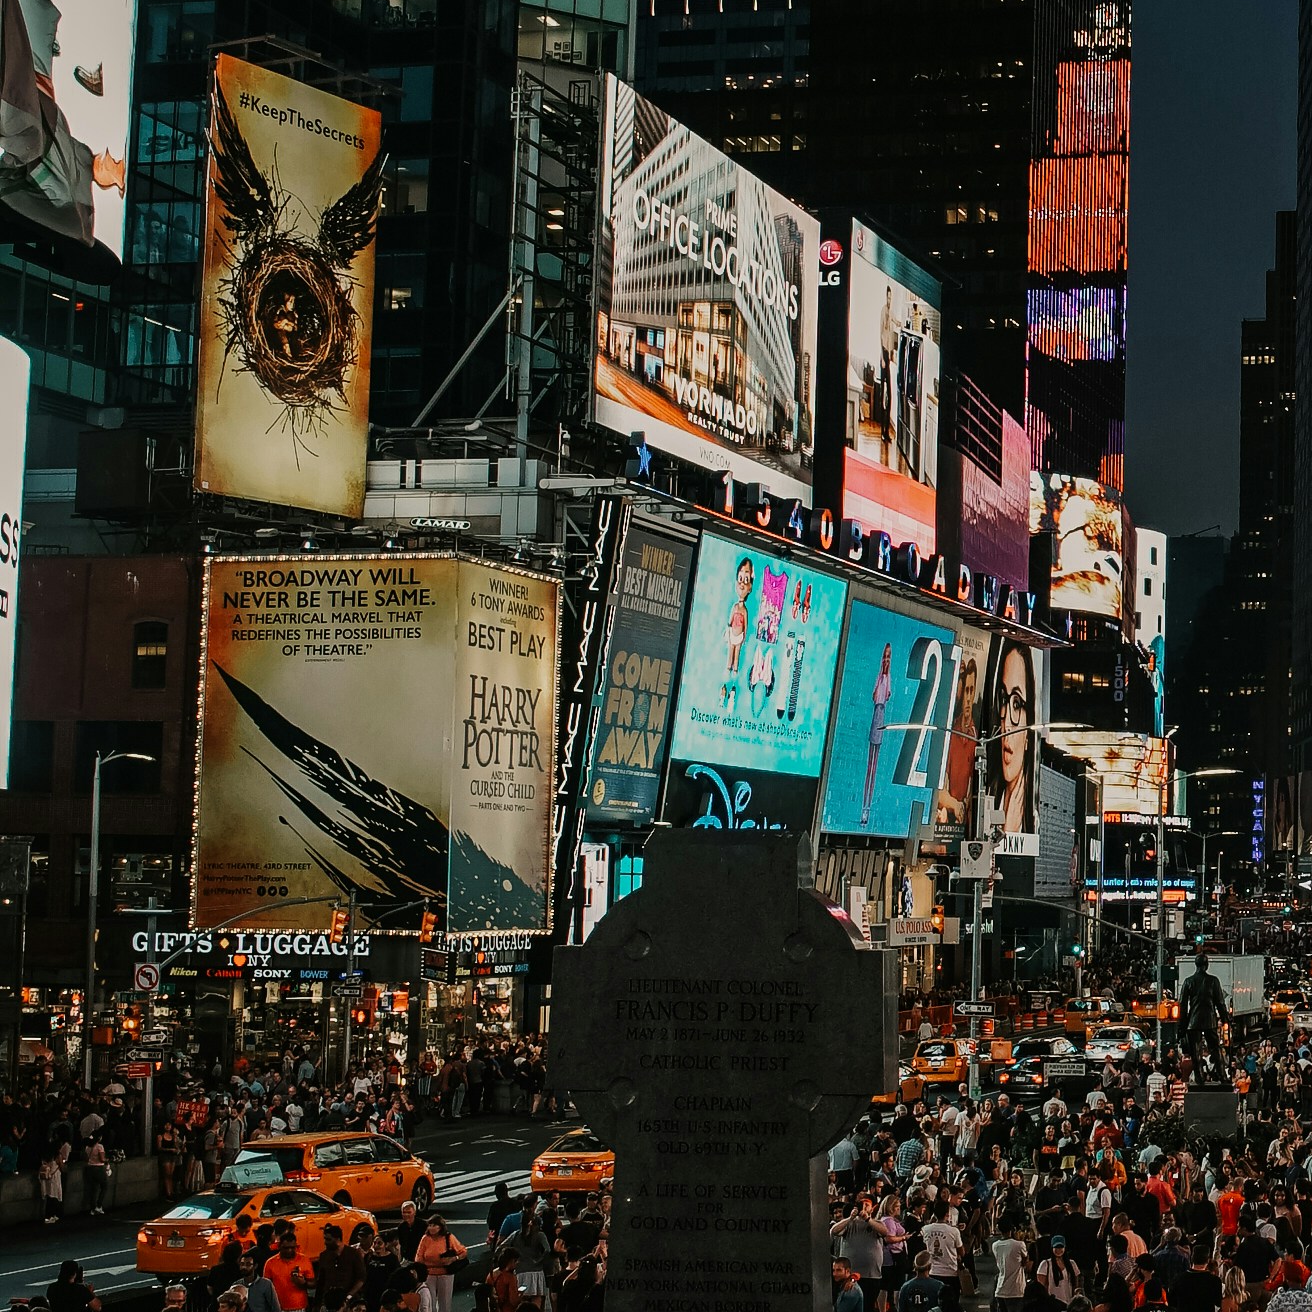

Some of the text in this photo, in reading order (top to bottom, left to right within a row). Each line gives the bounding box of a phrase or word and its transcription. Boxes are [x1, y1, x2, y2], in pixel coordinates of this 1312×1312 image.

[239, 91, 365, 151] #KeepTheSecrets
[706, 198, 737, 238] PRIME
[633, 189, 800, 321] OFFICE LOCATIONS
[674, 377, 757, 435] VORNADO
[687, 413, 745, 446] REALTY TRUST
[721, 472, 1036, 626] 1540 BROADWAY
[641, 542, 676, 577] WINNER!
[369, 567, 422, 586] WILL
[489, 577, 529, 601] WINNER!
[623, 565, 682, 608] BEST MUSICAL
[223, 588, 437, 610] NEVER BE THE SAME.
[470, 592, 545, 622] 6 TONY AWARDS
[233, 610, 423, 625] A THEATRICAL MARVEL THAT
[231, 626, 422, 642] REDEFINES THE POSSIBILITIES
[468, 621, 546, 660] BEST PLAY
[282, 644, 302, 657] OF
[612, 650, 673, 696] COME
[469, 674, 542, 731] HARRY
[604, 686, 668, 732] FROM
[690, 707, 743, 729] Discover what's
[462, 718, 545, 773] POTTER
[597, 725, 663, 769] AWAY
[470, 779, 535, 800] CURSED CHILD
[1003, 835, 1025, 854] DKNY
[204, 862, 312, 870] LYRIC 43RD STREET
[906, 920, 919, 934] POLO
[132, 931, 371, 956] GIFTS LUGGAGE
[481, 934, 532, 951] LUGGAGE
[247, 954, 272, 967] NY
[494, 964, 513, 974] SONY
[168, 967, 198, 977] Nikon
[253, 968, 292, 978] SONY
[299, 969, 330, 980] BOWER
[628, 978, 805, 997] LIEUTENANT COLONEL
[615, 999, 820, 1024] FRANCIS DUFFY
[625, 1027, 806, 1044] MAY 26 1932
[639, 1054, 791, 1071] CATHOLIC PRIEST
[674, 1096, 752, 1111] CHAPLAIN
[637, 1119, 679, 1134] 165TH
[657, 1141, 688, 1154] OLD
[656, 1184, 788, 1200] LIFE OF SERVICE
[697, 1201, 724, 1215] FOR
[630, 1216, 793, 1233] GOD AND COUNTRY
[624, 1259, 794, 1274] SPANISH AMERICAN WAR
[642, 1279, 680, 1291] YORK
[760, 1281, 811, 1295] GUARD
[645, 1300, 710, 1312] MEXICAN
